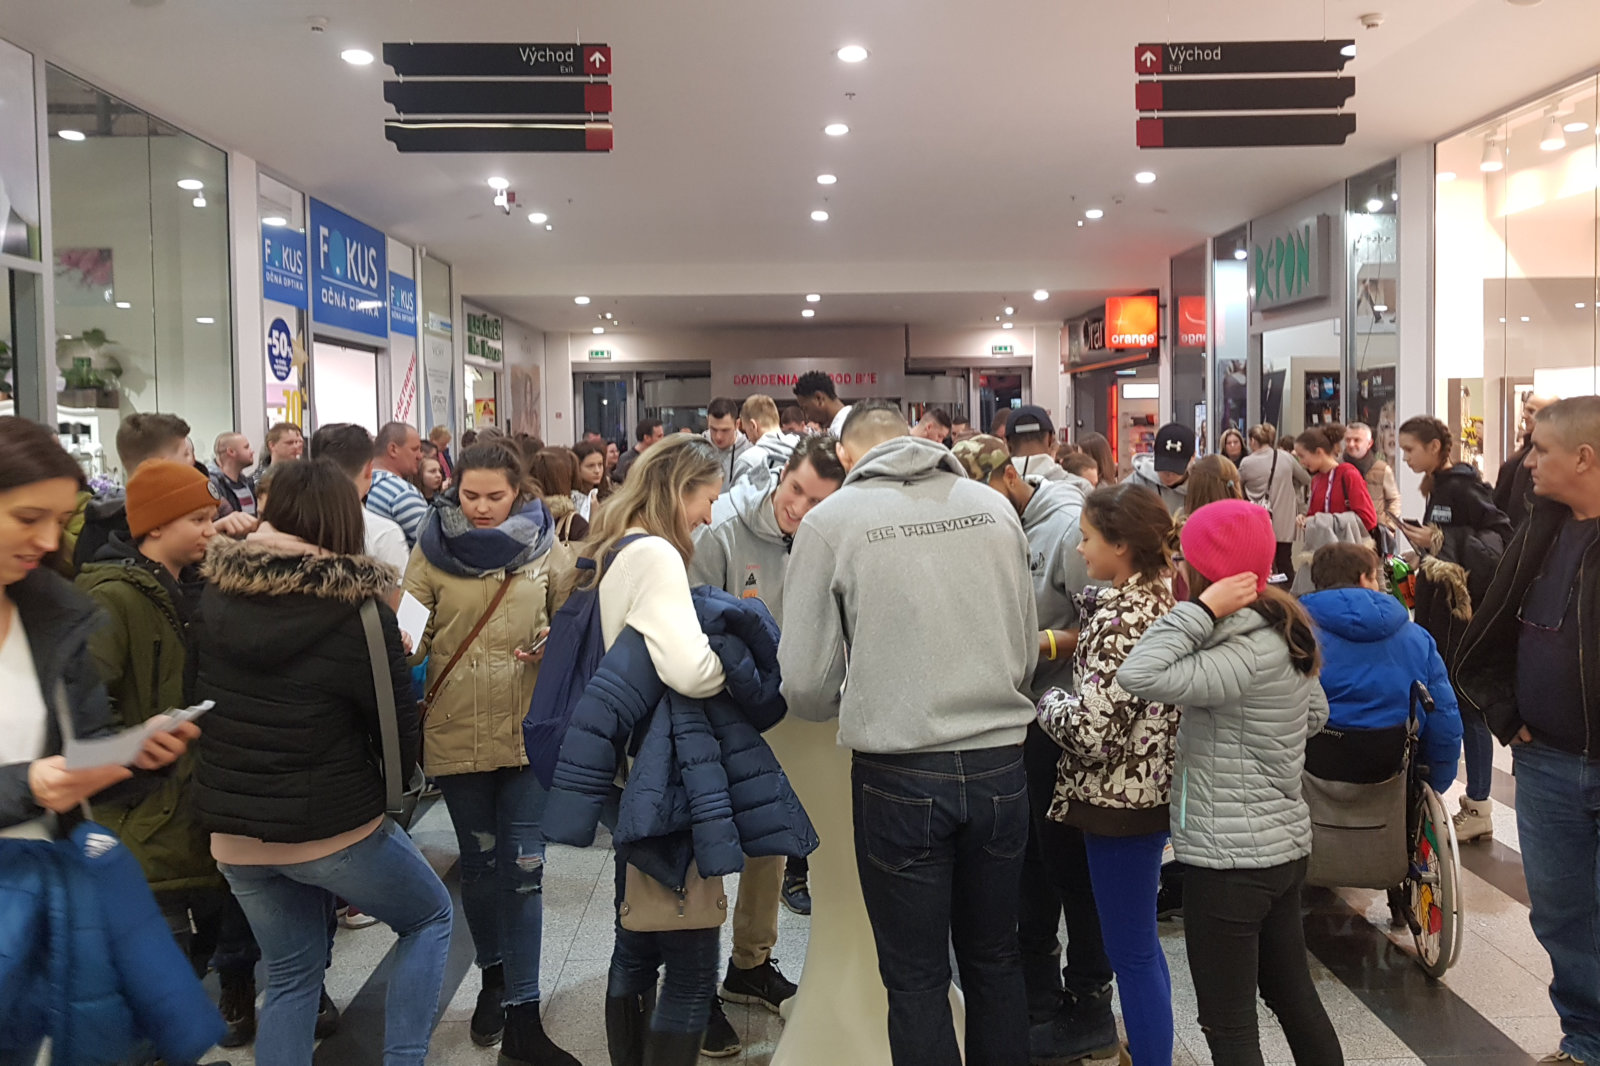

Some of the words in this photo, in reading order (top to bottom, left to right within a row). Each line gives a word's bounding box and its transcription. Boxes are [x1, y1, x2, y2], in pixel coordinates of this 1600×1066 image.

[519, 46, 574, 65] Východ
[1168, 45, 1222, 64] Východ
[560, 65, 574, 74] Exit
[1169, 64, 1182, 73] Exit
[1255, 224, 1311, 304] BEPON
[283, 275, 304, 292] OPTIKA
[321, 286, 347, 310] OČNÁ
[267, 329, 293, 358] -50%
[1111, 332, 1156, 346] orange
[733, 373, 798, 386] DOVIDENIA
[827, 372, 852, 385] OOD
[855, 372, 878, 385] BYE
[866, 525, 896, 543] BC
[899, 512, 996, 537] PRIEVIDZA
